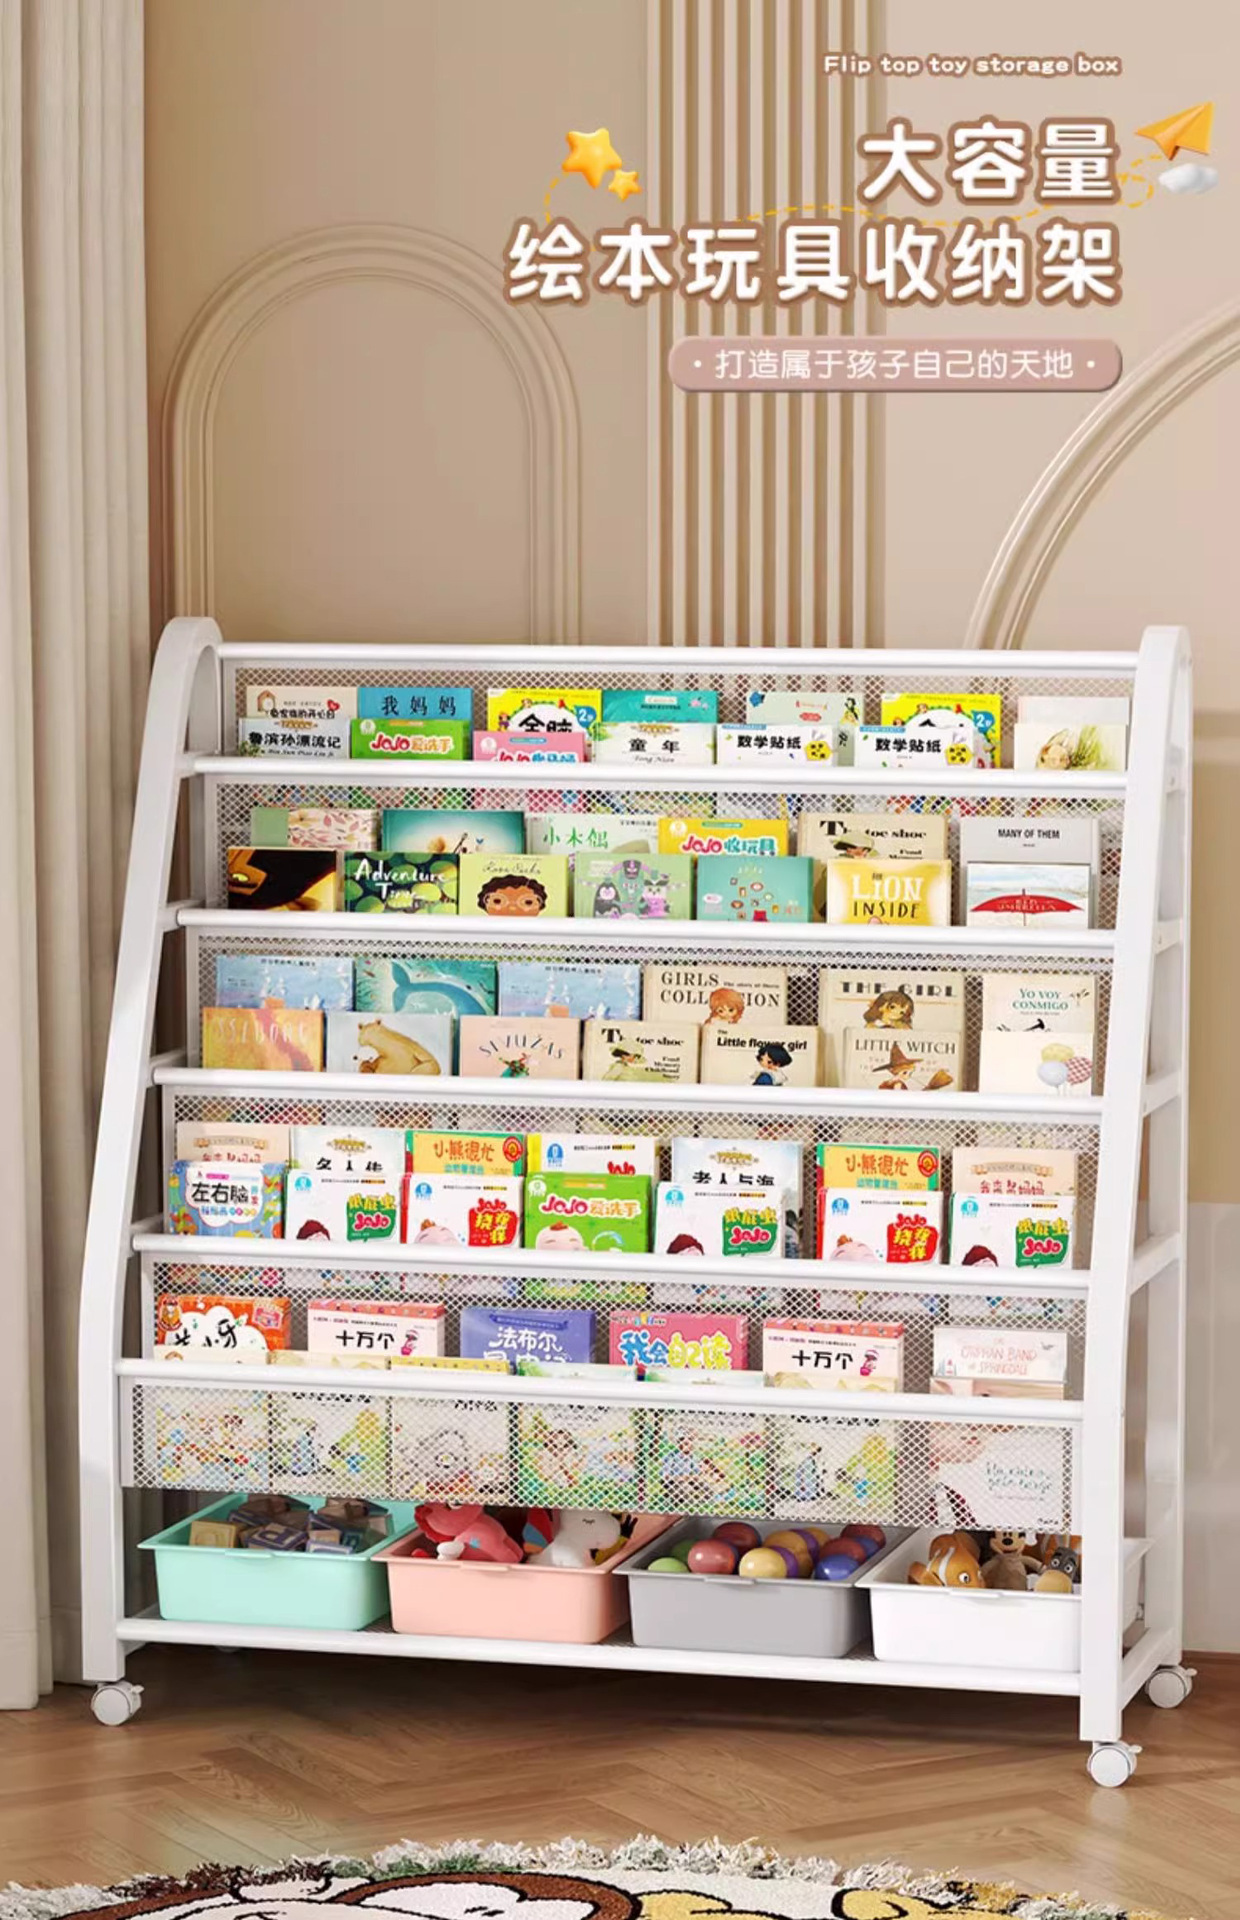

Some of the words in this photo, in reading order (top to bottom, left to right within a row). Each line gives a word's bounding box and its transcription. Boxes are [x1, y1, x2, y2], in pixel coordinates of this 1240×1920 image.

[382, 695, 456, 716] 我妈妈
[248, 731, 341, 749] 鲁滨孙漂流记
[629, 738, 680, 754] 童年
[737, 735, 802, 750] 数学贴纸
[875, 738, 941, 753] 数学贴纸
[998, 829, 1022, 839] MANY
[1024, 829, 1035, 838] OF
[1037, 829, 1060, 839] THEM
[853, 900, 920, 918] INSIDE
[661, 971, 719, 986] GIRLS
[717, 1036, 747, 1047] Little
[787, 1041, 808, 1052] girl
[907, 1041, 956, 1054] WITCH
[192, 1182, 248, 1204] 左右脑
[335, 1330, 395, 1350] 十万个
[488, 1326, 563, 1352] 法布尔
[791, 1350, 853, 1370] 十万个
